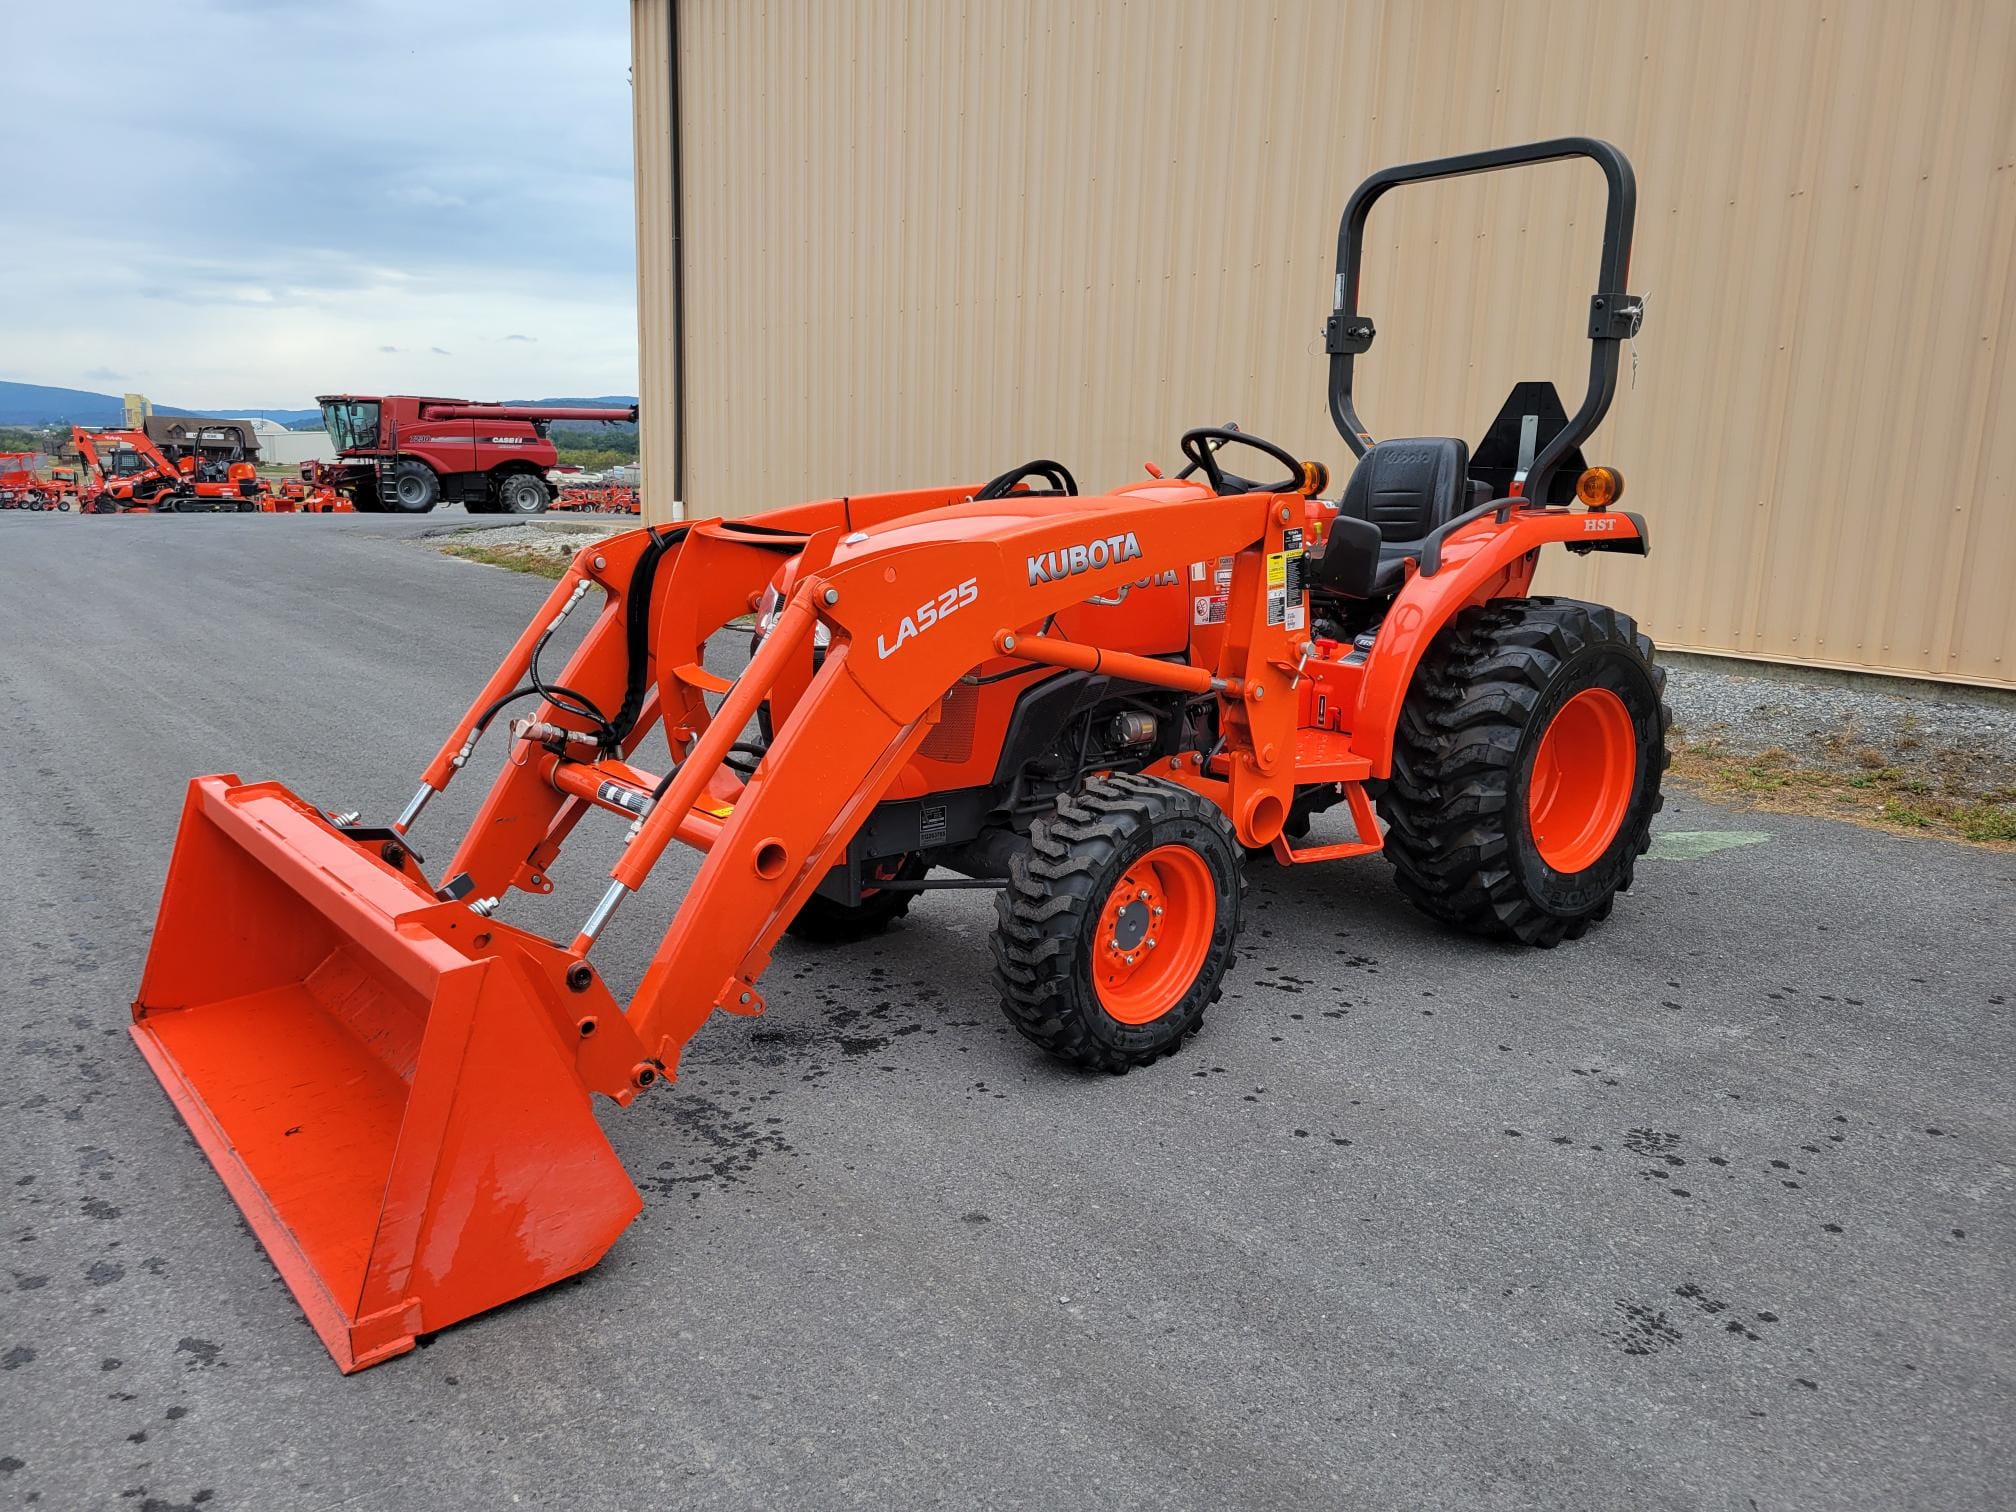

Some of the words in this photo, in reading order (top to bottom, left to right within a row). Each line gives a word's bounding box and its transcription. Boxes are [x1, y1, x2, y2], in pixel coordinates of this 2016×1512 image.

[1583, 518, 1617, 531] HST
[1027, 531, 1143, 587] KUBOTA
[877, 576, 978, 660] LA525
